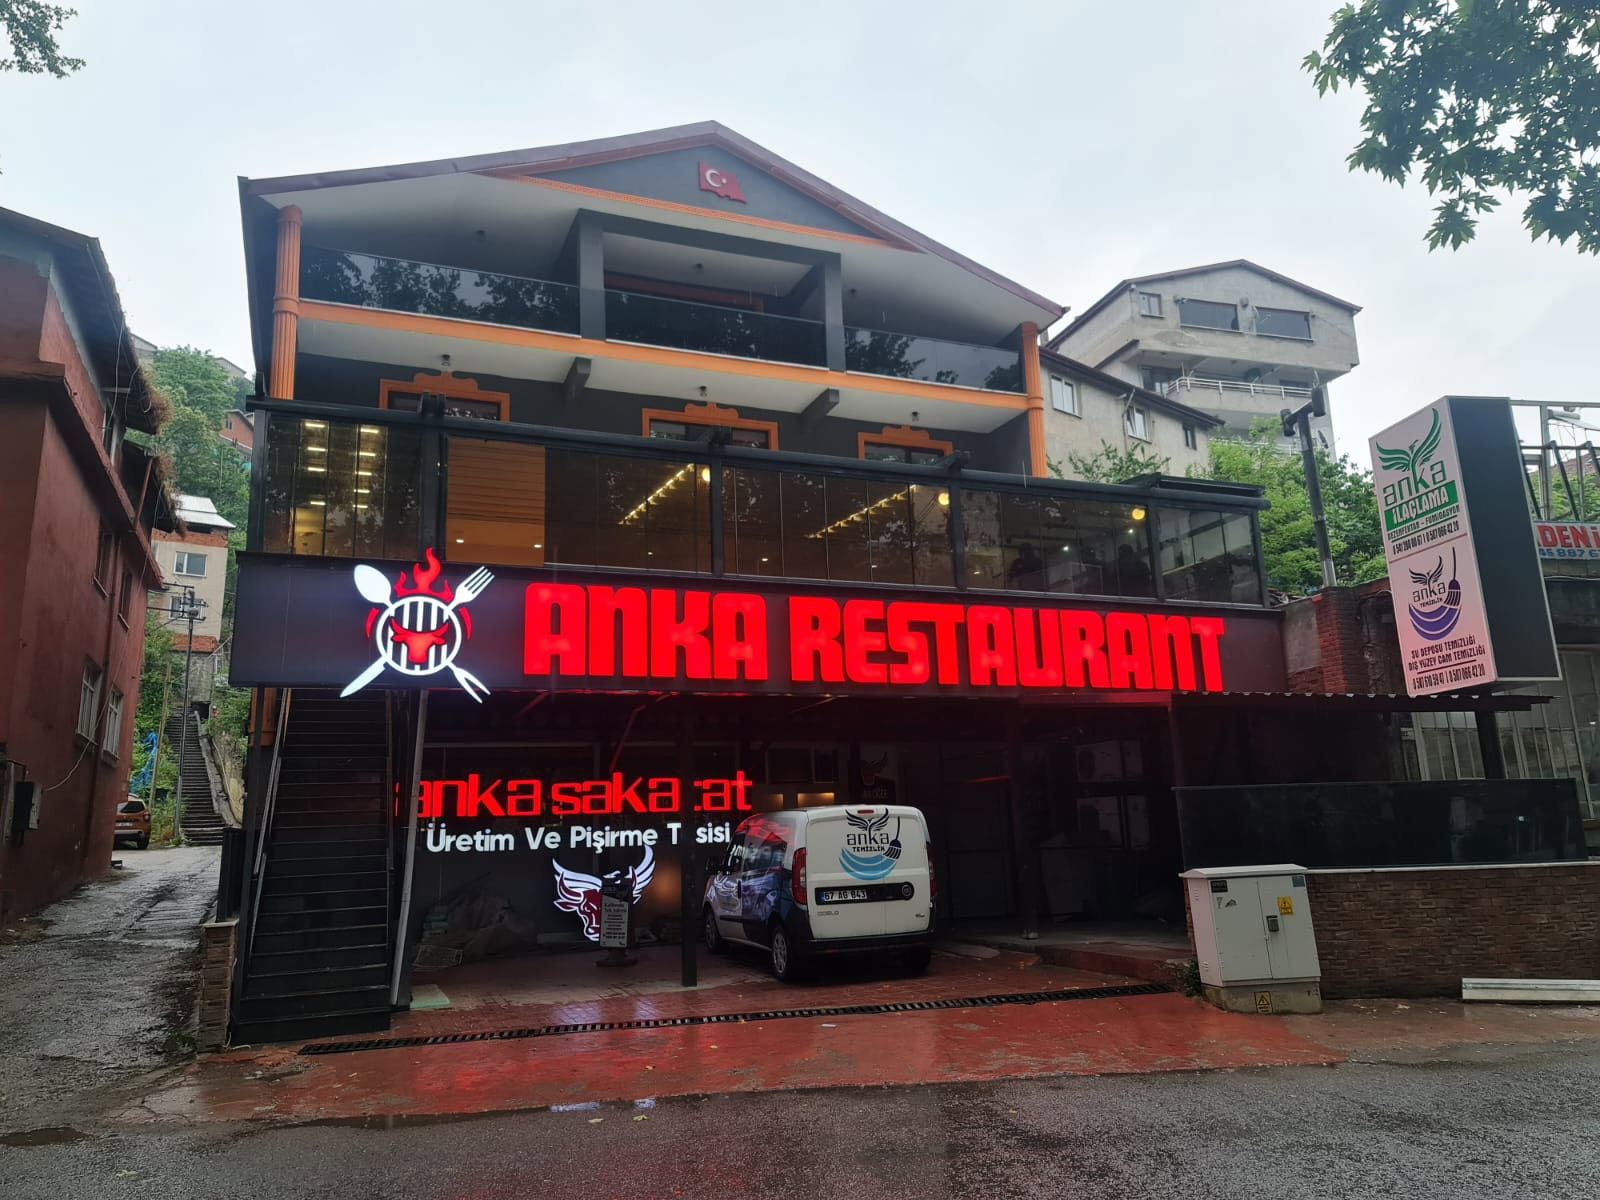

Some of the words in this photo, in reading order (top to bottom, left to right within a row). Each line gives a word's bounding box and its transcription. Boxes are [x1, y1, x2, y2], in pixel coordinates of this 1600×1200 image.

[1383, 460, 1447, 507] anka
[1392, 486, 1449, 524] İLAÇLAMA
[1537, 525, 1600, 548] DENİ
[1556, 549, 1585, 557] 887
[1413, 582, 1446, 602] anka
[524, 582, 768, 680] ANKA
[789, 595, 1224, 692] RESTAURANT
[1411, 649, 1419, 660] SU
[1421, 643, 1443, 657] DEPOSU
[1438, 653, 1452, 665] CAM
[551, 771, 752, 815] sakaat
[426, 822, 515, 853] Üretim
[525, 827, 561, 850] Ve
[570, 825, 659, 854] Pişirme
[666, 822, 731, 845] Tsisi
[846, 832, 890, 845] anka
